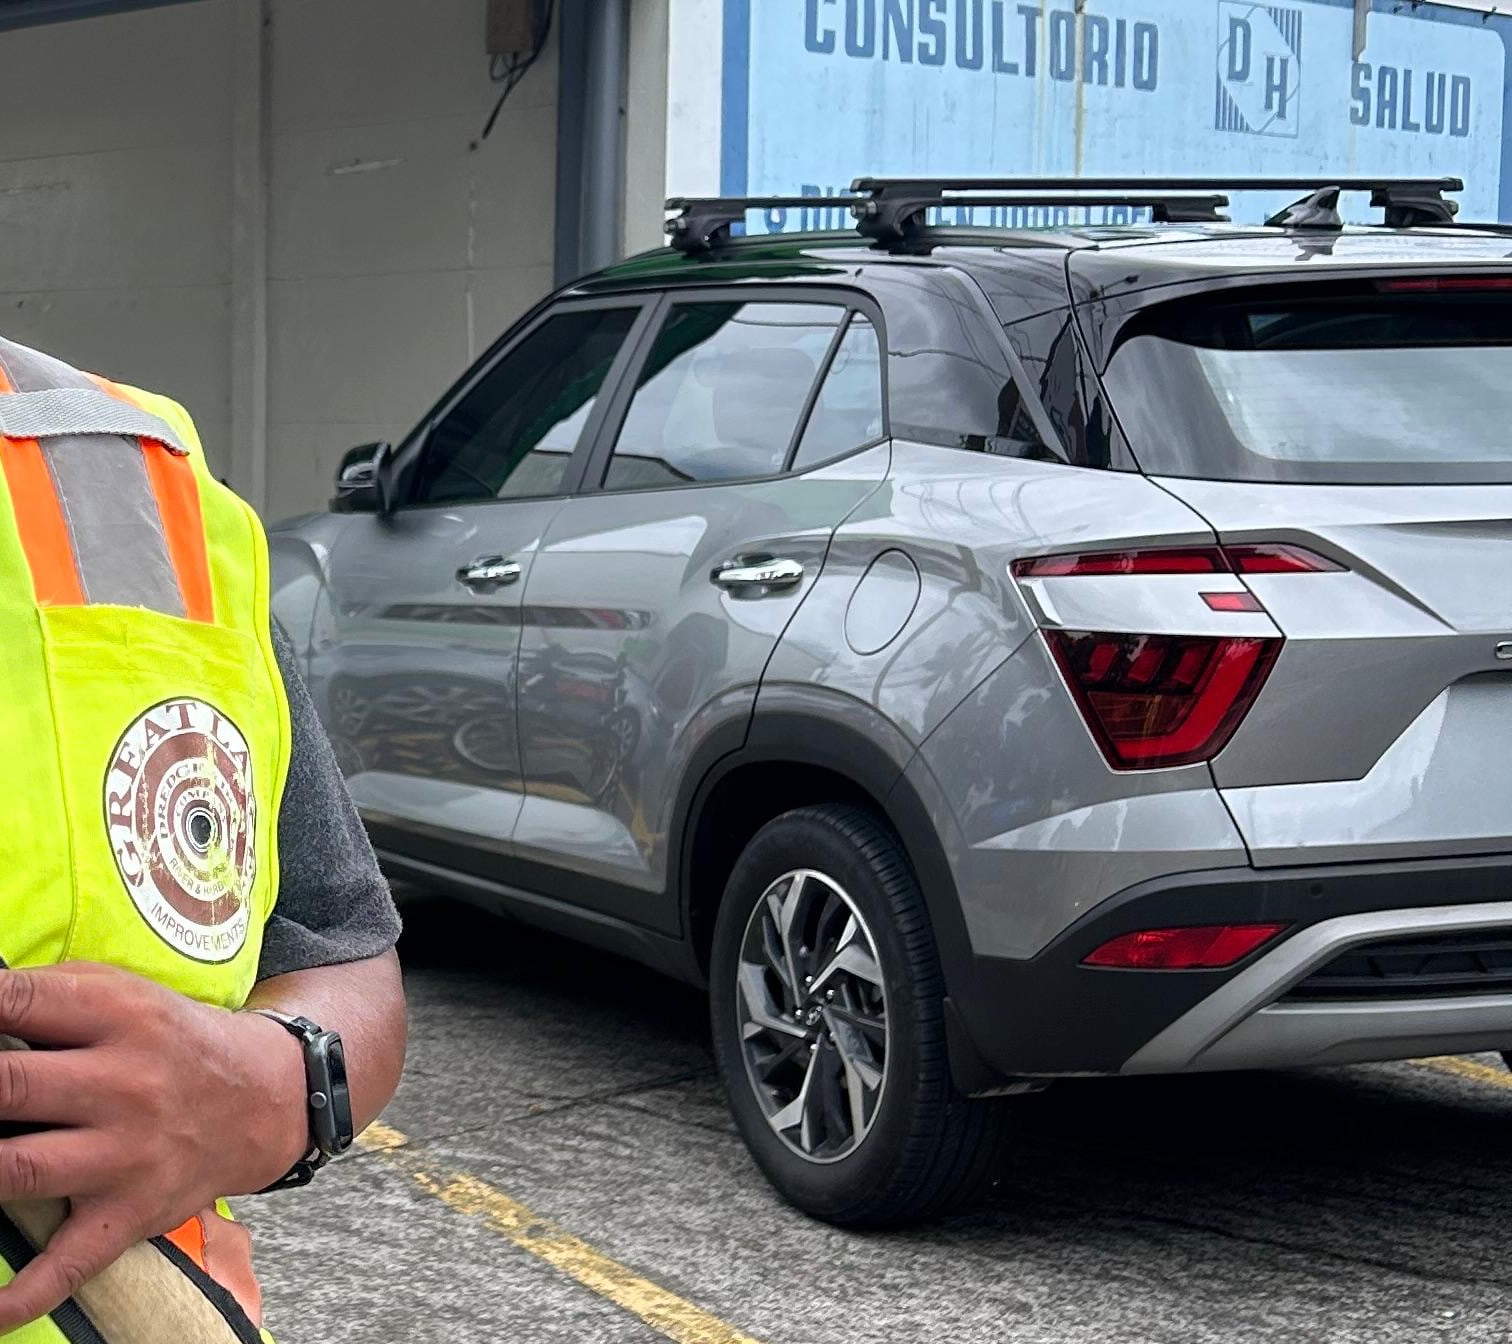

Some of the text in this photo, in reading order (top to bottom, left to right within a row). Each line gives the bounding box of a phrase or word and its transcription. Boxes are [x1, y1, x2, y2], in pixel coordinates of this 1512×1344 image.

[1349, 62, 1471, 137] SALUD
[108, 702, 197, 888] GREAT
[151, 902, 245, 951] IMPROVEMENTS
